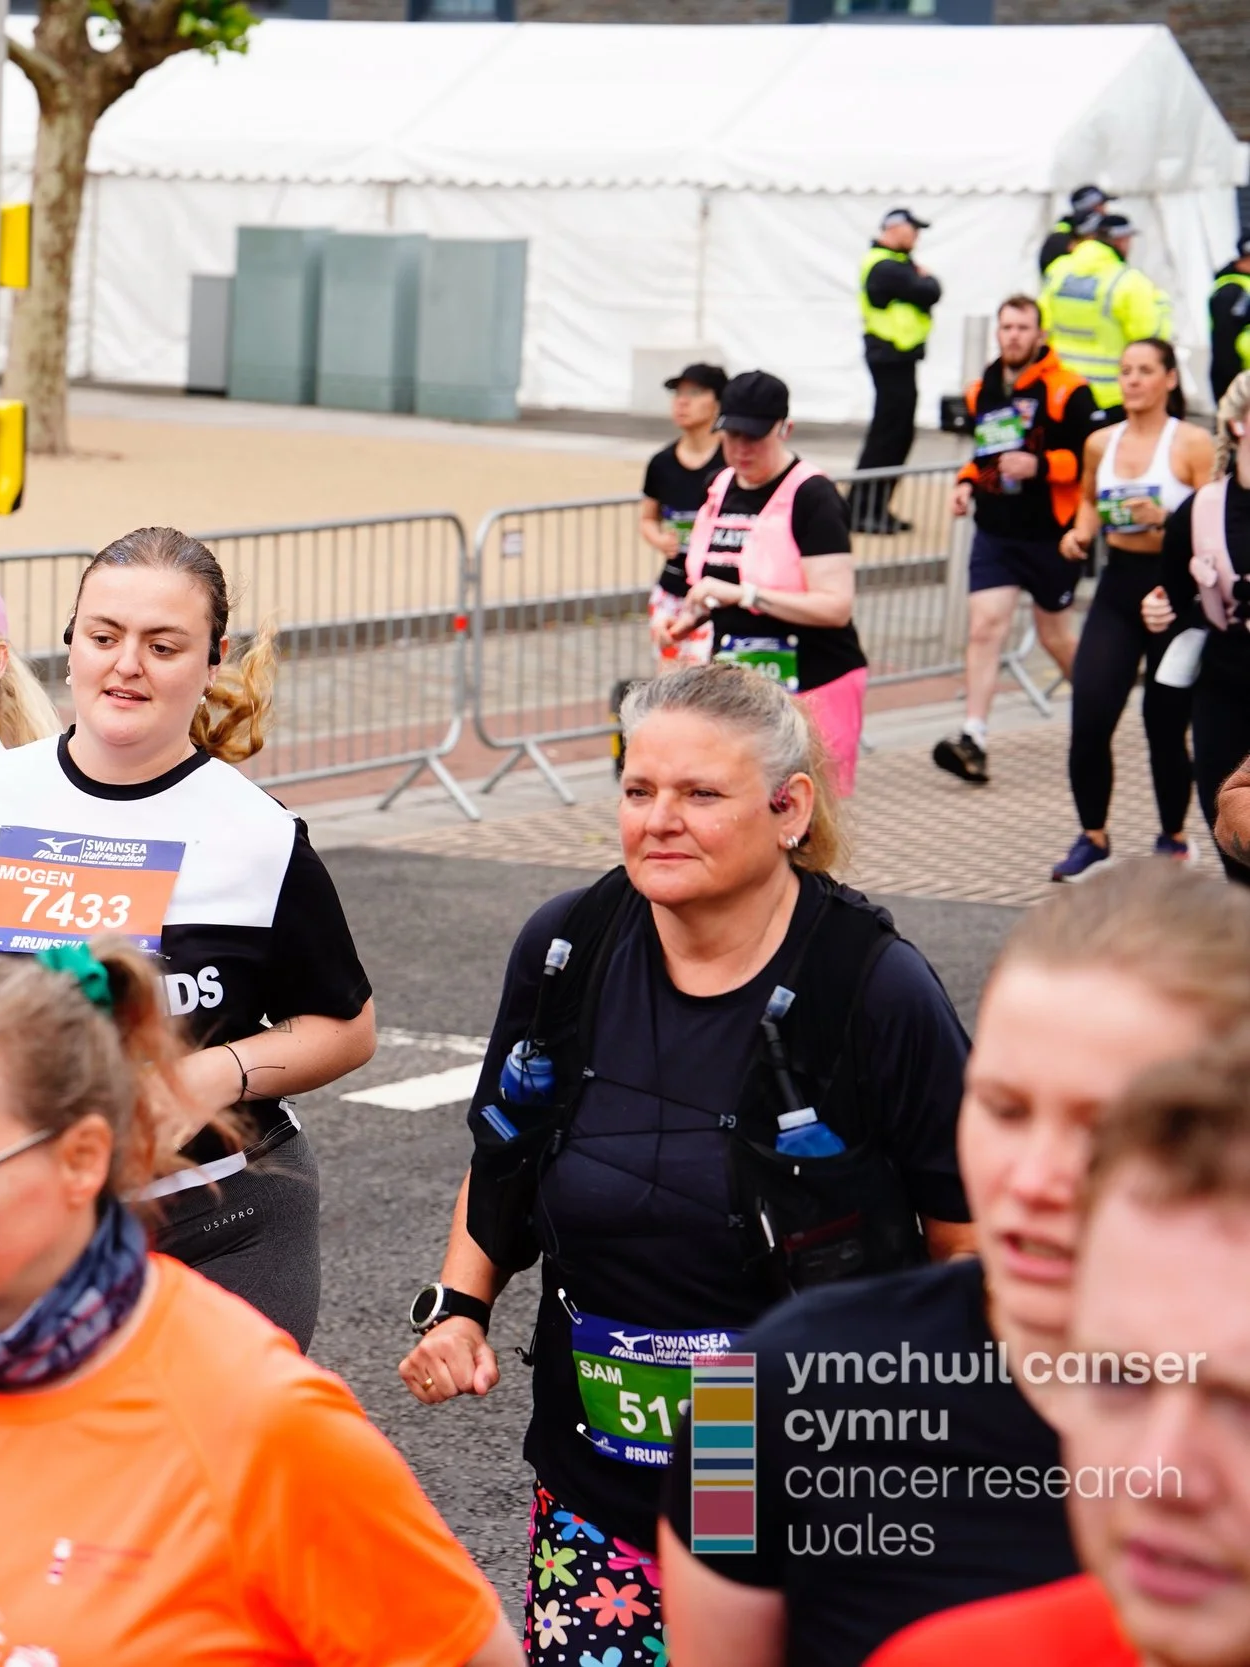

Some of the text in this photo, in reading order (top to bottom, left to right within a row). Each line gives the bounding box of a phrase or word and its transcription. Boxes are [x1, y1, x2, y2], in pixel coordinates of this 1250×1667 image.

[84, 839, 147, 854] SWANSEA
[21, 886, 132, 929] 7433
[654, 1333, 731, 1350] SWANSEA
[579, 1360, 623, 1386] SAM
[625, 1445, 674, 1465] #RUN
